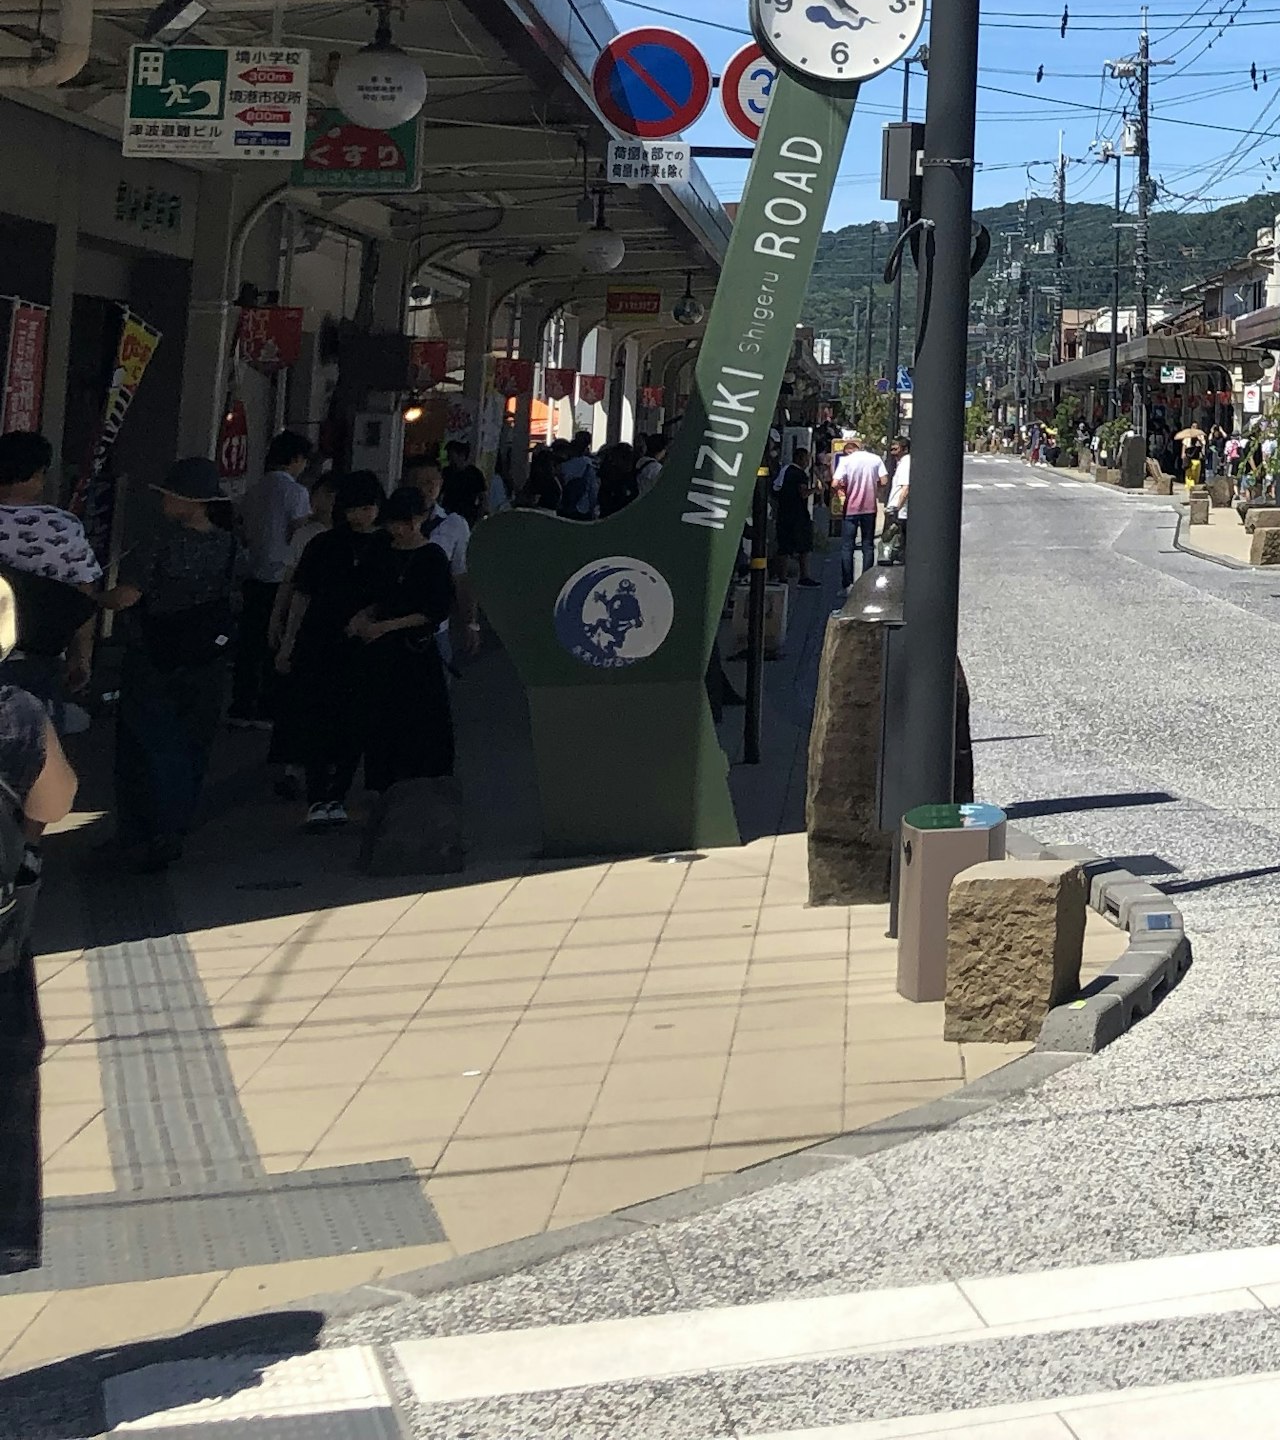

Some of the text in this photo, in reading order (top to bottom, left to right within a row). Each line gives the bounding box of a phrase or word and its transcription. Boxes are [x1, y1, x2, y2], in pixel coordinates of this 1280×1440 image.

[236, 50, 300, 65] 境小学校
[830, 41, 850, 65] 6
[249, 71, 287, 82] 300m
[748, 68, 774, 113] 3
[308, 144, 400, 167] くすり
[681, 134, 824, 531] MIZUKI Shigeru ROAD
